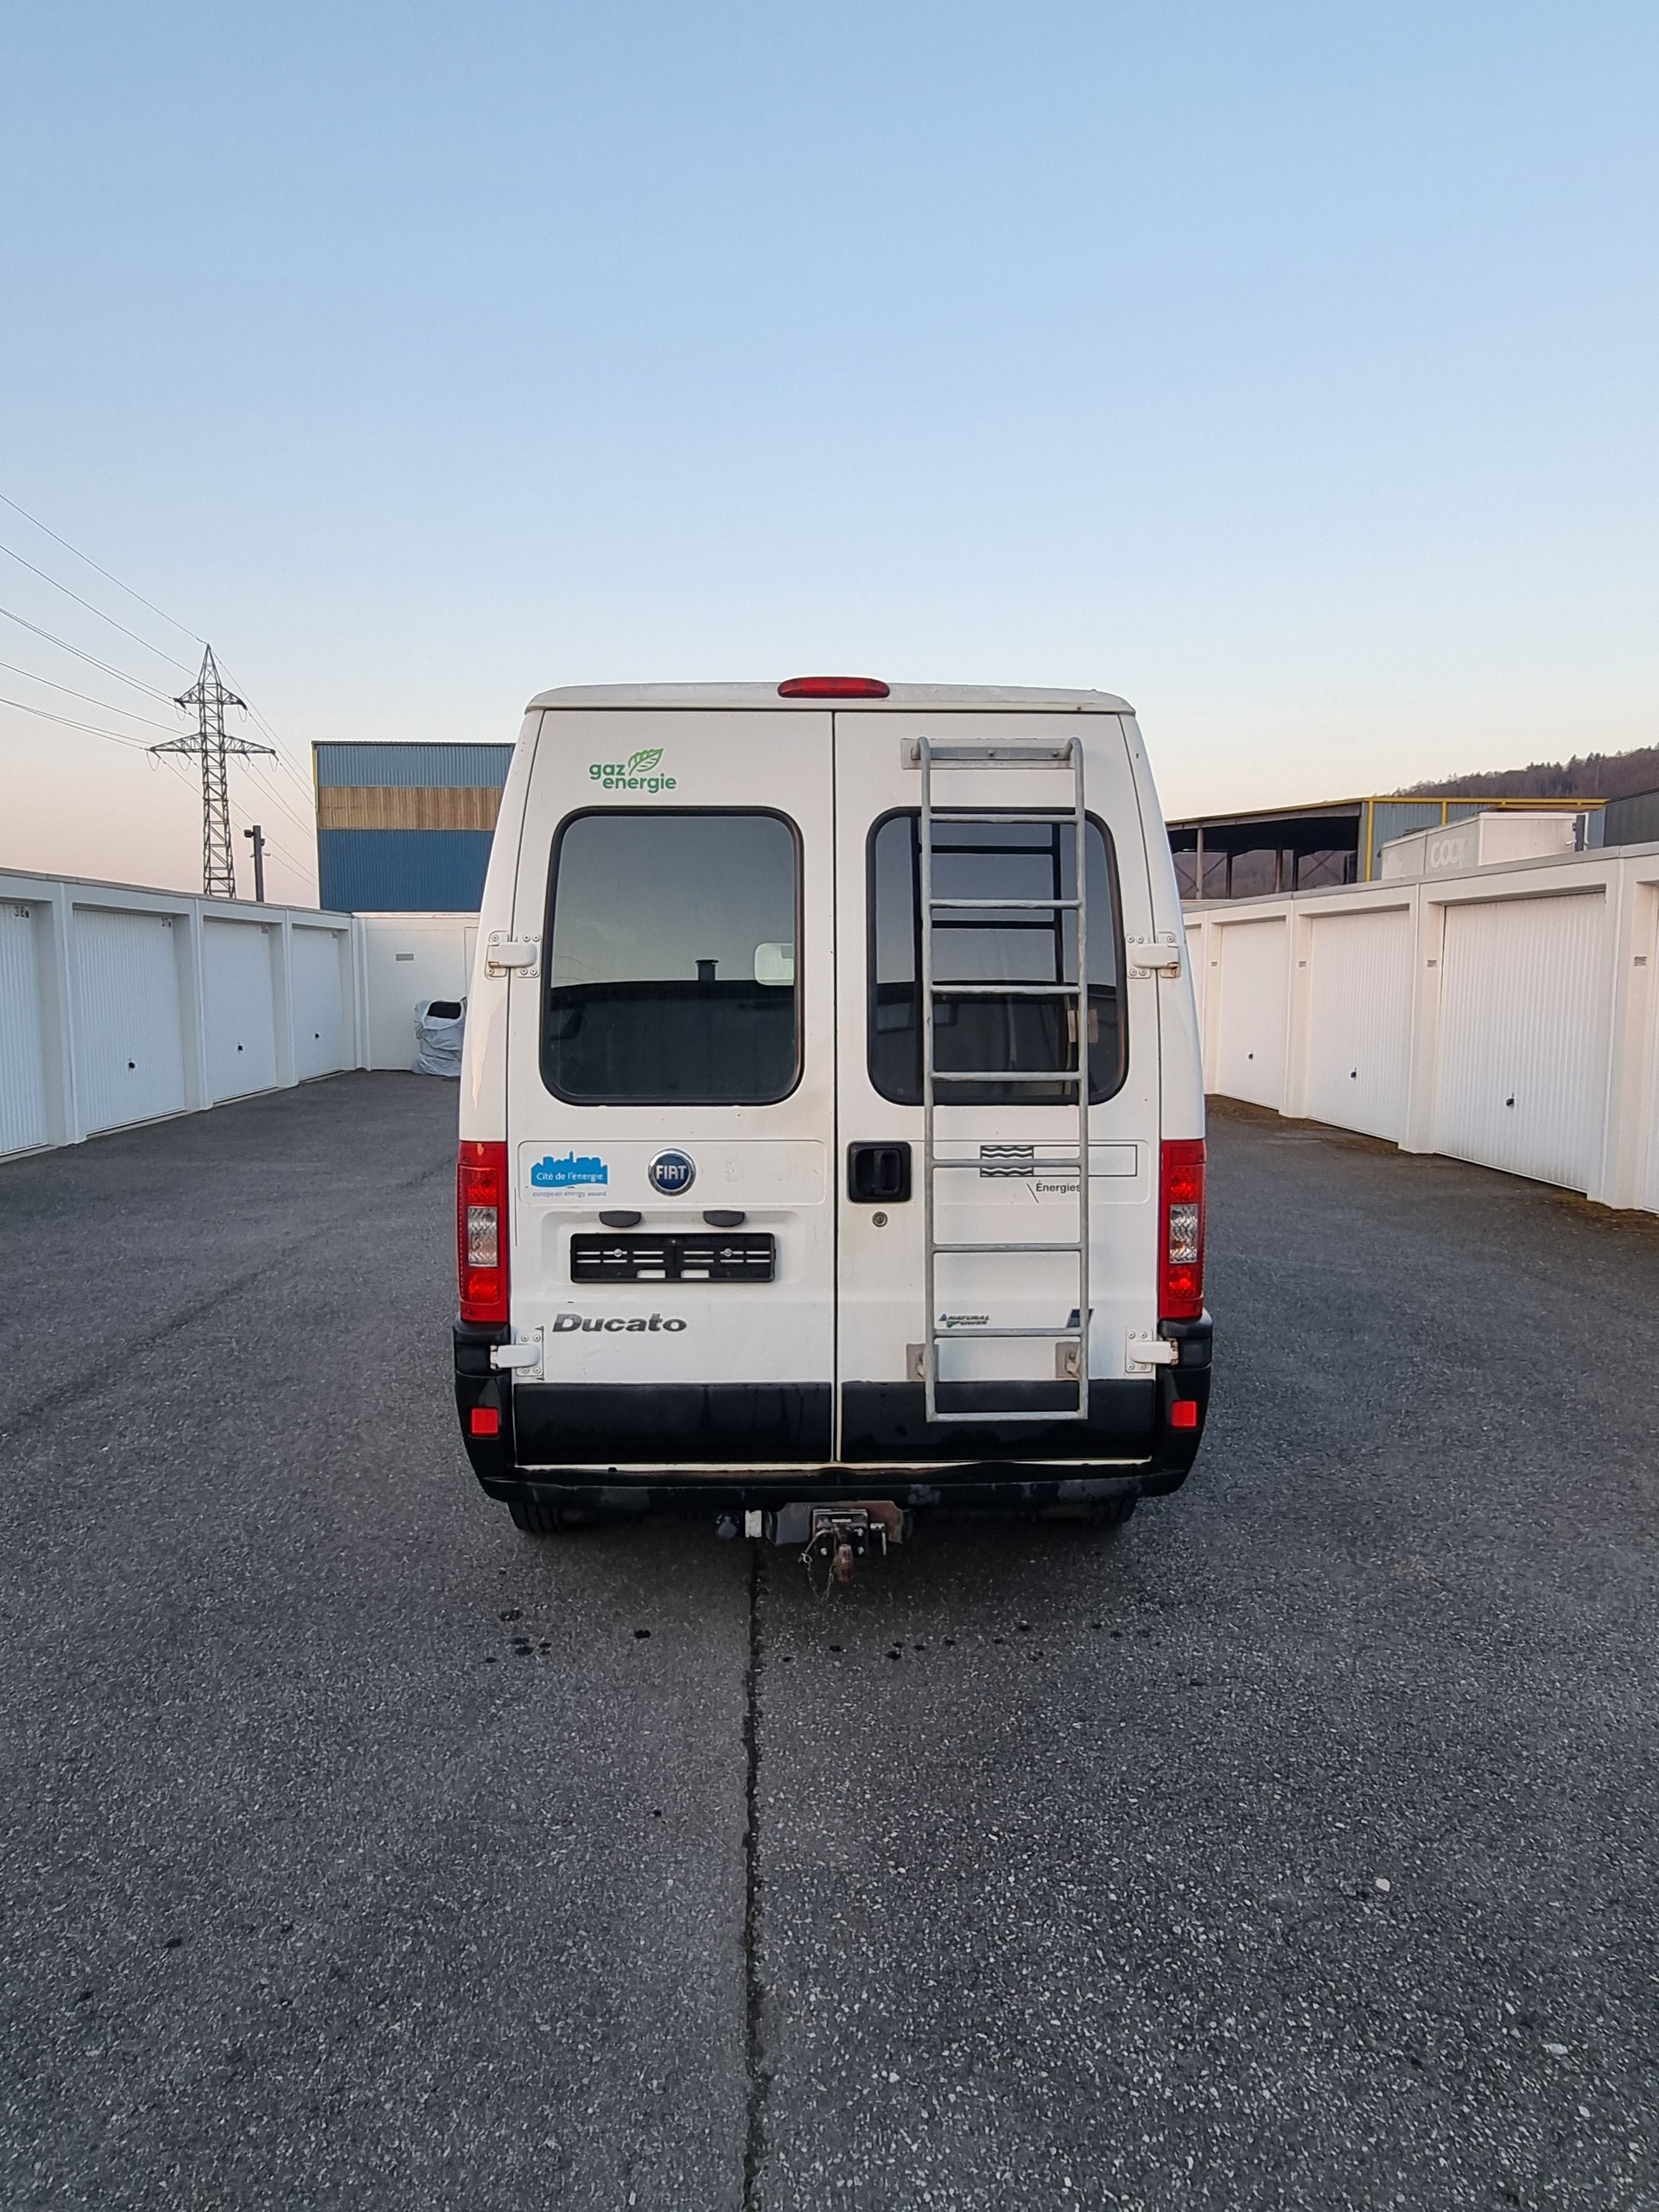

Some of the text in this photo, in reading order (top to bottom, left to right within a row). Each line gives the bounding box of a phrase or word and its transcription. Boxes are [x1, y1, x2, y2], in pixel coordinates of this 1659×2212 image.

[588, 764, 626, 780] gaz
[602, 772, 677, 794] energie
[536, 1172, 604, 1183] Cité de l'énergie
[656, 1165, 687, 1180] FIAT
[552, 1313, 688, 1332] Ducato
